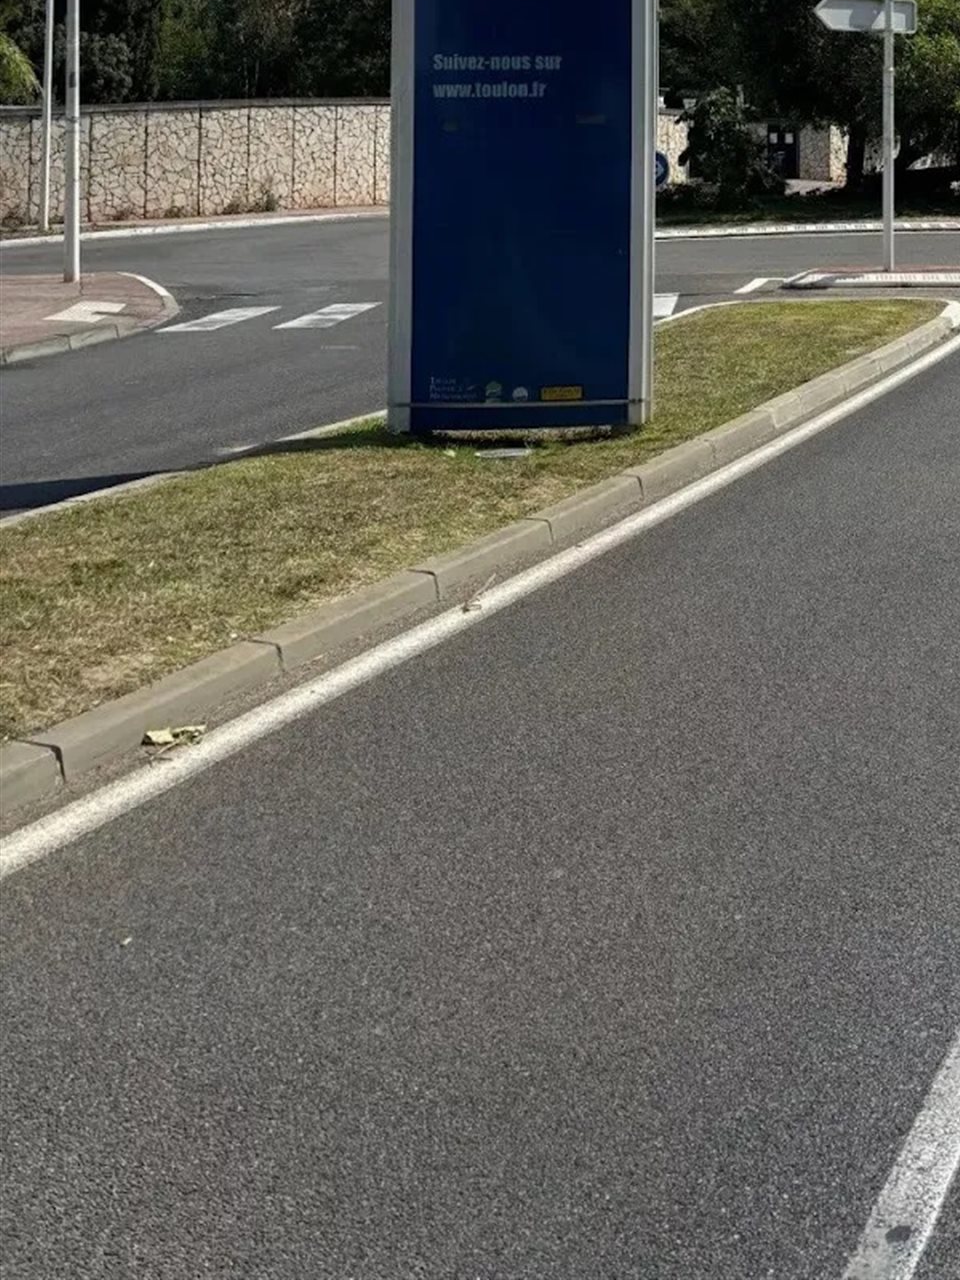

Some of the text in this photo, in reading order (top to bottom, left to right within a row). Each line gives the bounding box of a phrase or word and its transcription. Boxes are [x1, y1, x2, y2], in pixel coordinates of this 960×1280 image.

[433, 54, 562, 70] Suivez-nous sur
[433, 81, 547, 98] www.toulon.fr
